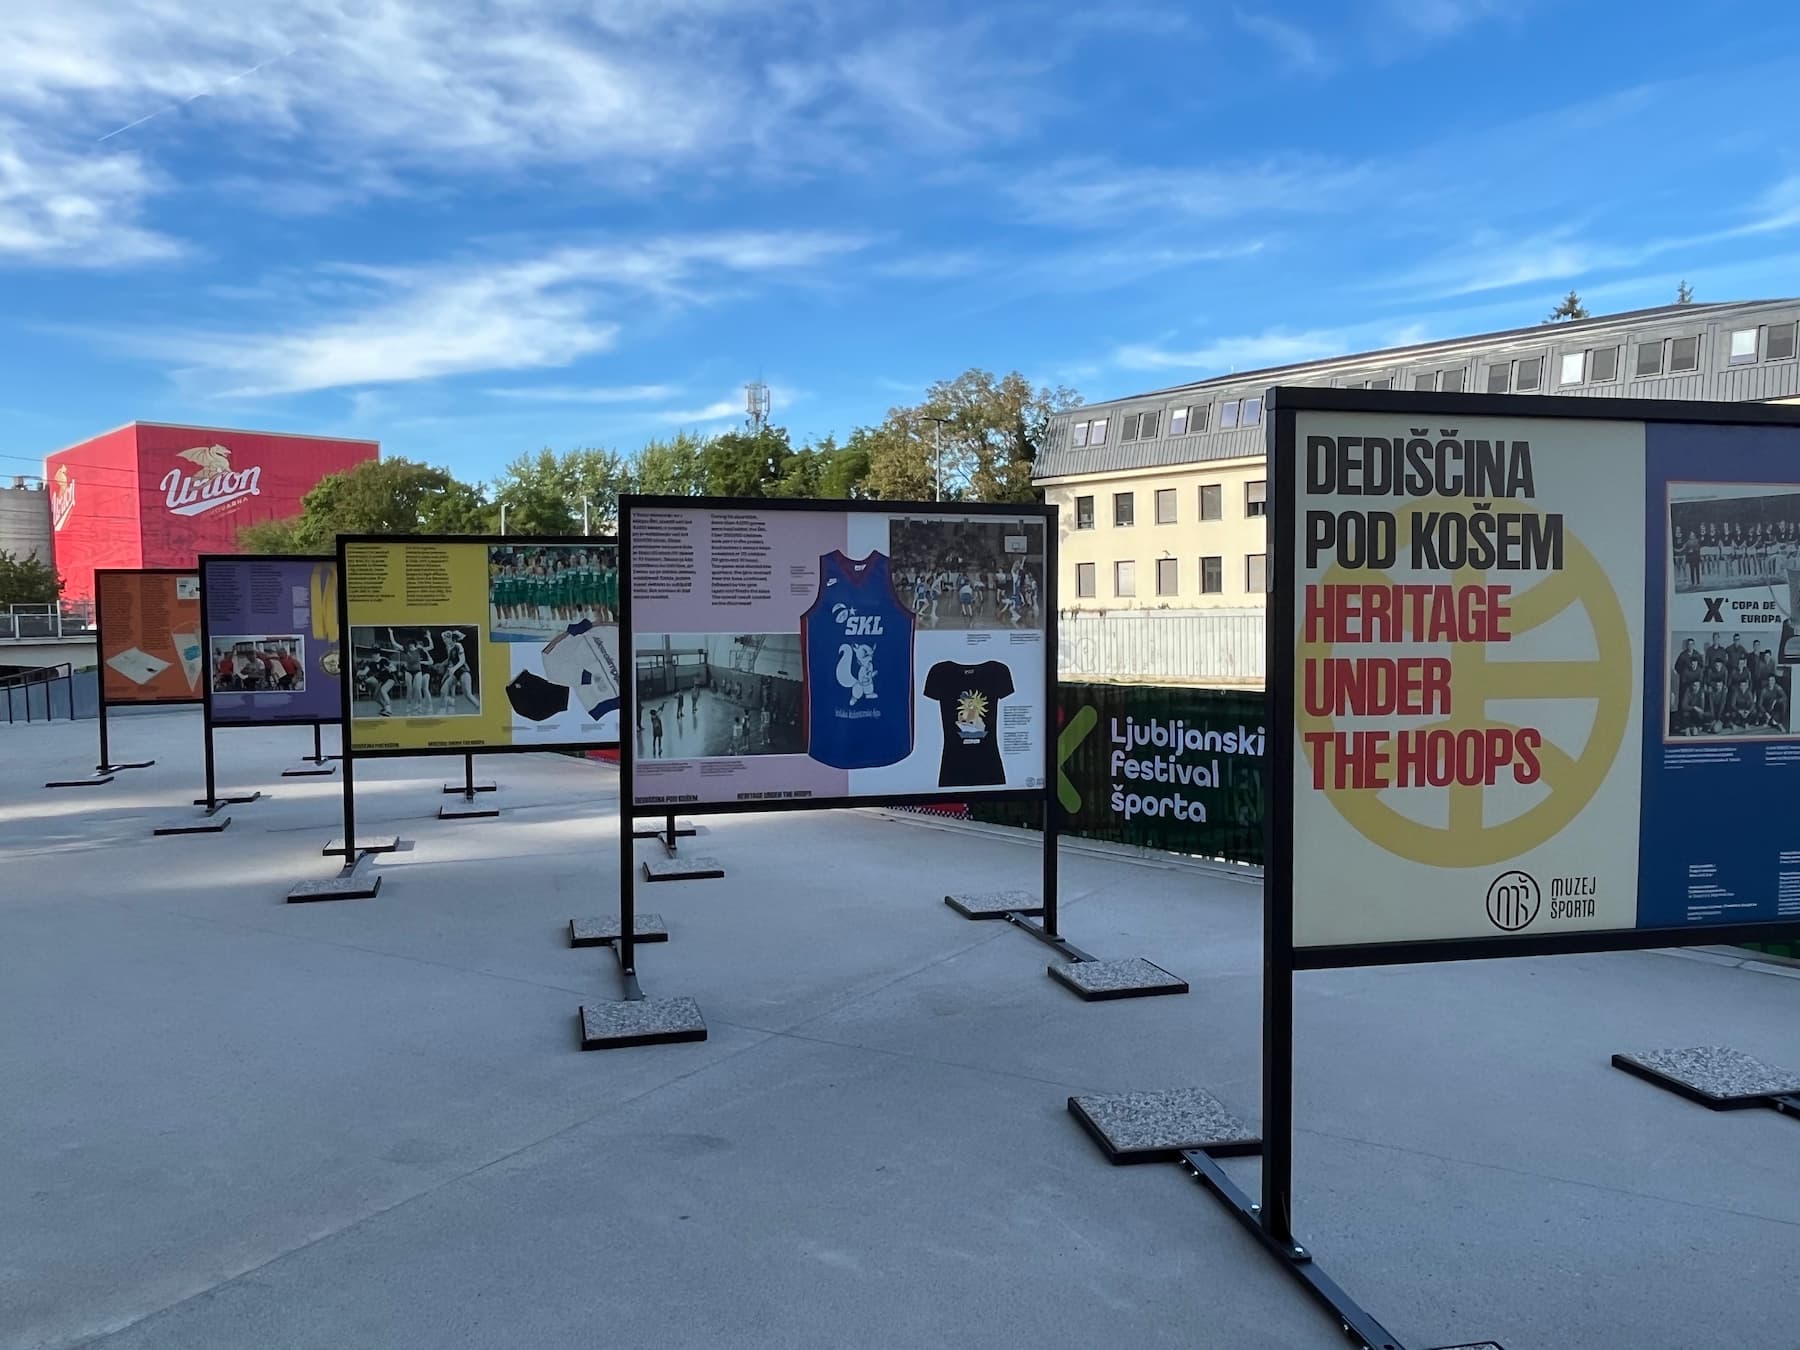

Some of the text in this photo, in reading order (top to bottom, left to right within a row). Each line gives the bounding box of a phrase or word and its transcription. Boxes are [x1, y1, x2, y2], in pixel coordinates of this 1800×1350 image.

[1306, 428, 1535, 499] DEDIŠČINA
[160, 466, 261, 510] Union
[1305, 503, 1563, 571] POD KOŠEM
[1305, 585, 1512, 643] HERITAGE
[1732, 601, 1759, 610] COPA
[1762, 601, 1776, 610] DE
[1740, 614, 1782, 624] EUROPA
[1305, 658, 1451, 717] UNDER
[1111, 716, 1265, 757] Ljubljanski
[1111, 749, 1220, 788] festival
[1305, 728, 1542, 790] THE HOOPS
[1111, 783, 1207, 823] športa
[1551, 876, 1596, 897] MUZEJ
[1550, 897, 1595, 919] ŠPORTA
